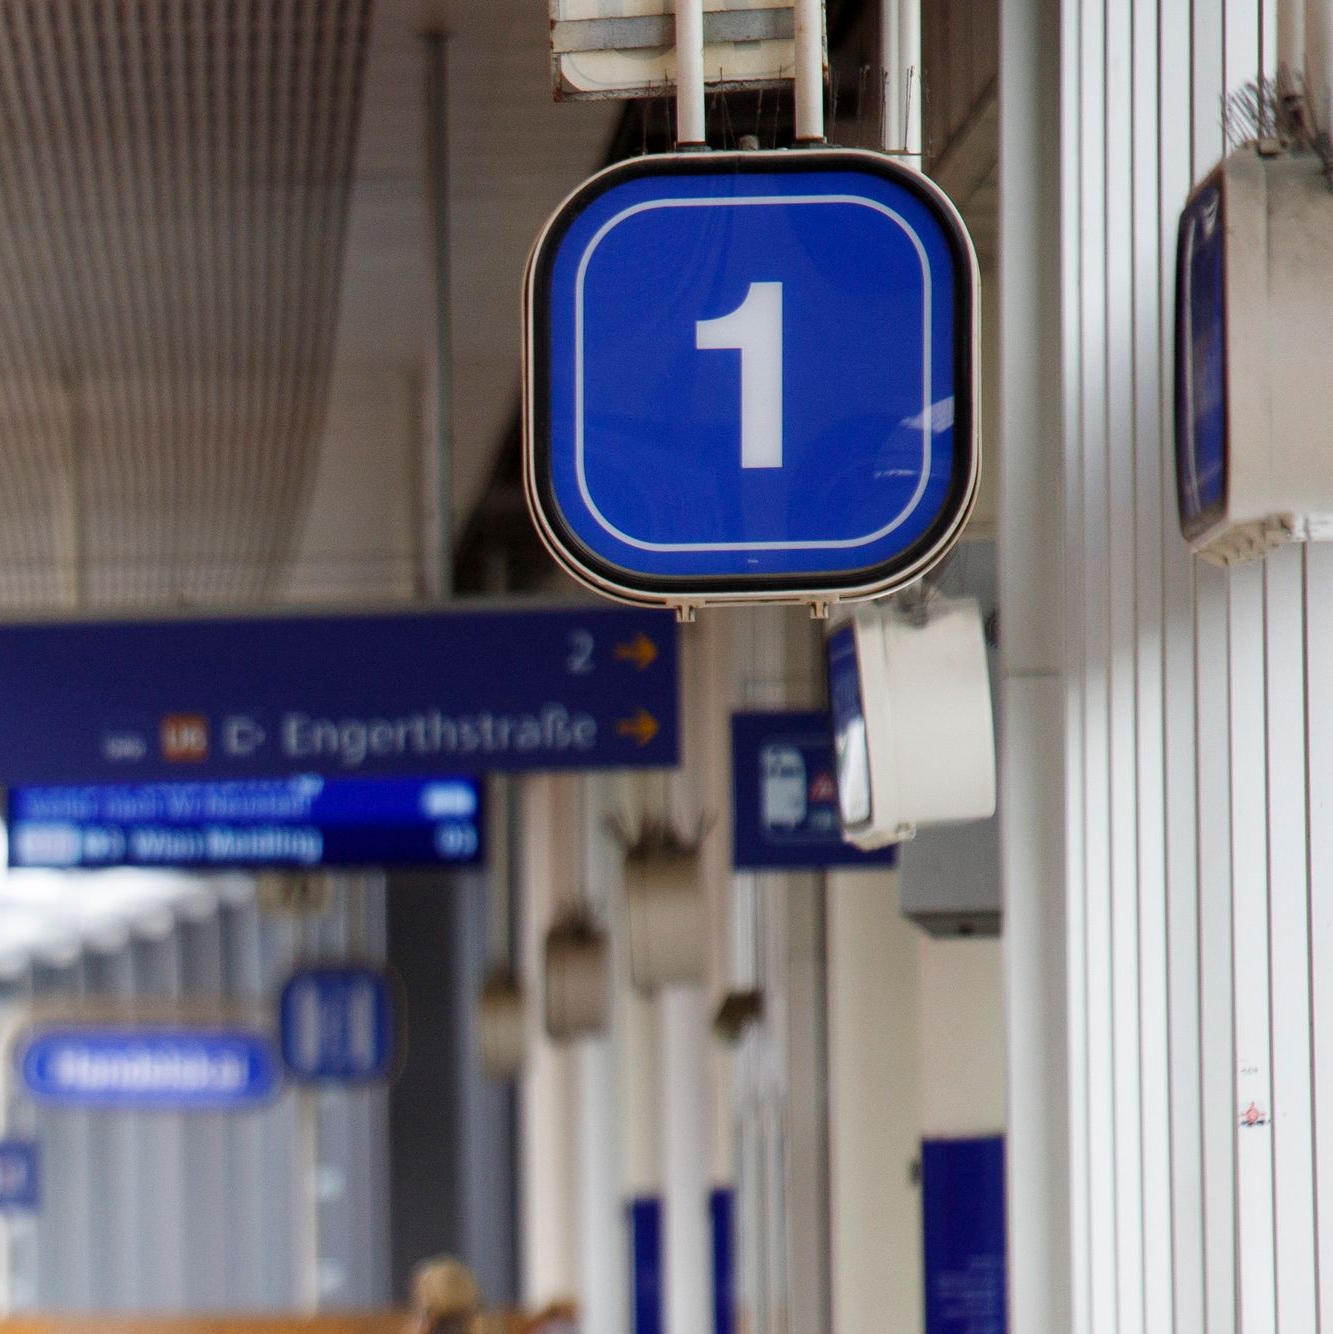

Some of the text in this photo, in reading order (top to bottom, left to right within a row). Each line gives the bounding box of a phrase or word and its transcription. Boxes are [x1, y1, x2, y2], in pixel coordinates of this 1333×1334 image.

[696, 282, 783, 468] 1
[567, 629, 595, 674] 2
[283, 703, 597, 763] Engerthstraße
